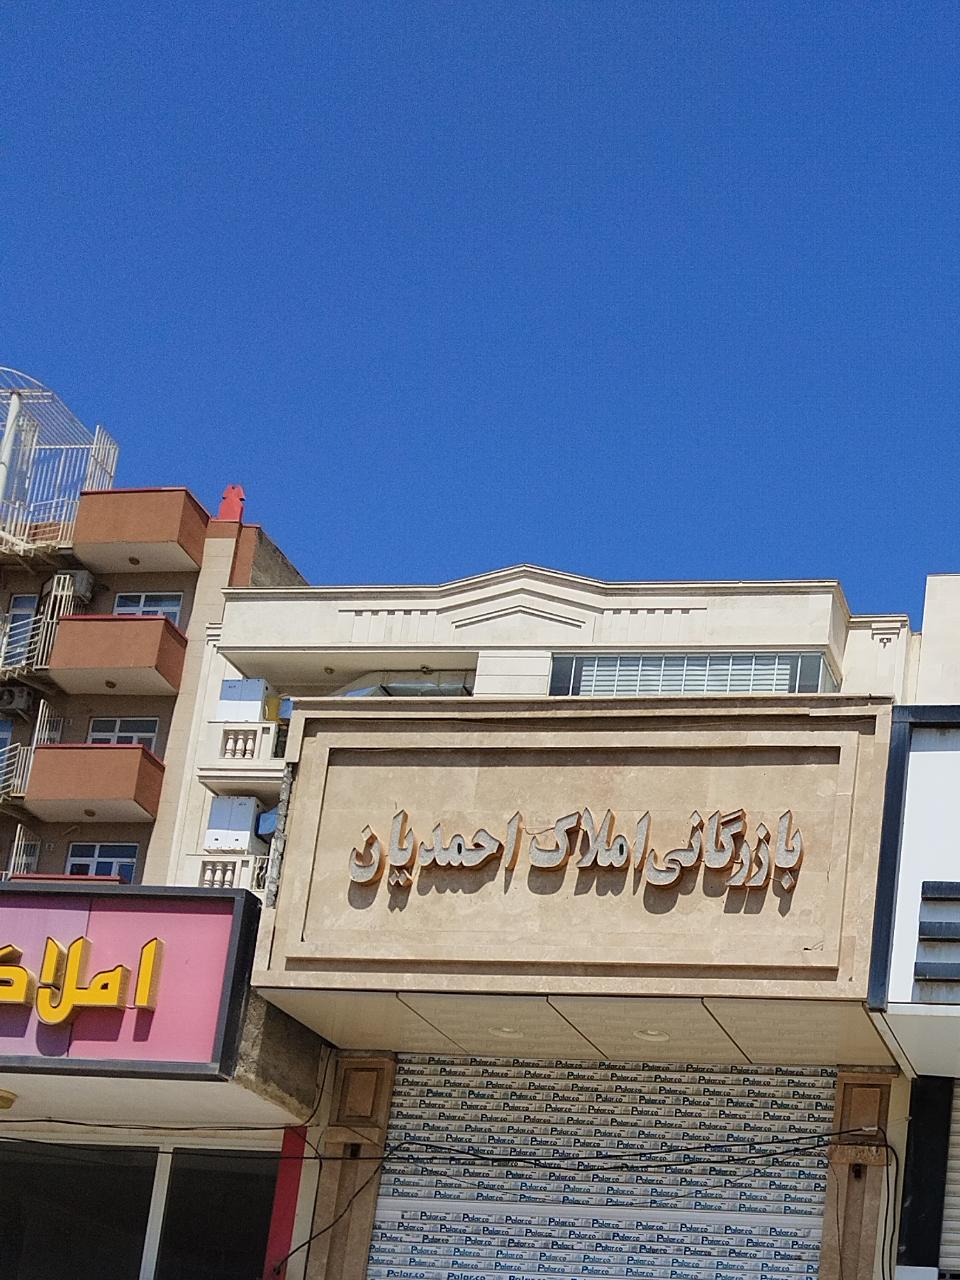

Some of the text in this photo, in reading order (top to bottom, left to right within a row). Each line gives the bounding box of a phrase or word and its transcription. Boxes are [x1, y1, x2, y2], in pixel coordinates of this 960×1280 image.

[348, 806, 804, 891] بازرگانی املاک احمدیان
[386, 1269, 426, 1279] Palar.co
